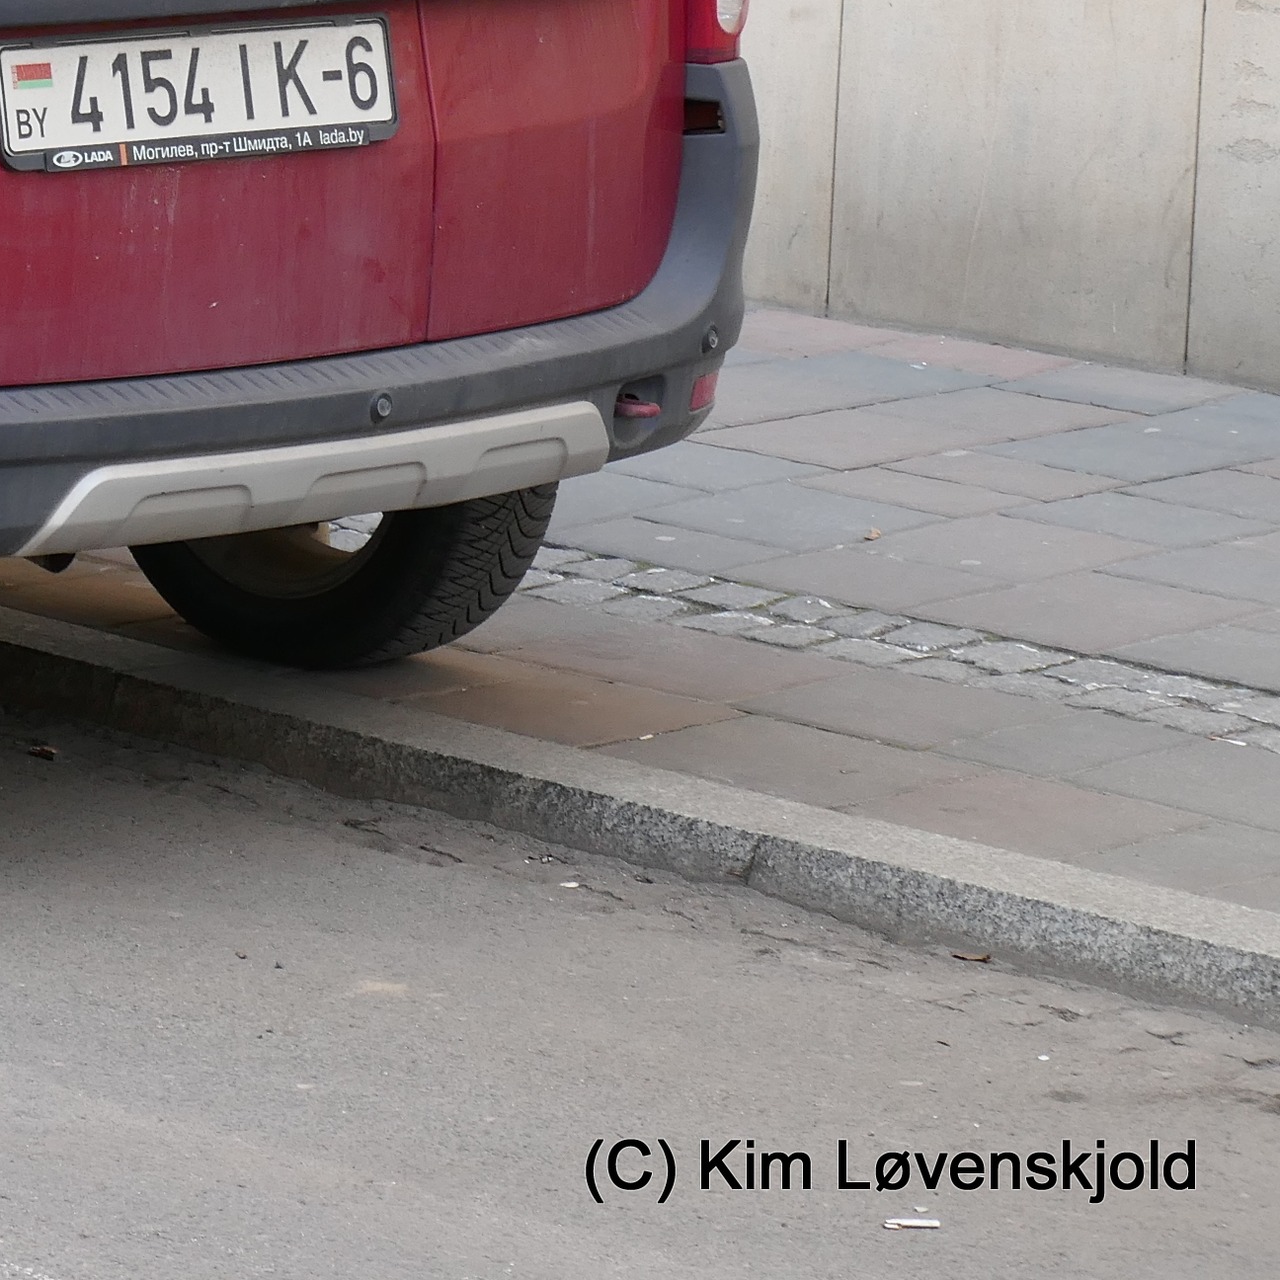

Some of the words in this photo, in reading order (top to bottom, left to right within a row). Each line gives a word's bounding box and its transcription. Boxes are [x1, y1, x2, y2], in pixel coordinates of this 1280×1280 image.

[71, 47, 215, 132] 4154
[16, 107, 48, 139] BY
[84, 150, 113, 163] LADA
[132, 143, 199, 160] Могилев,
[201, 141, 231, 157] пр-т
[233, 136, 292, 153] Шмидта,
[319, 127, 365, 145] lada.by
